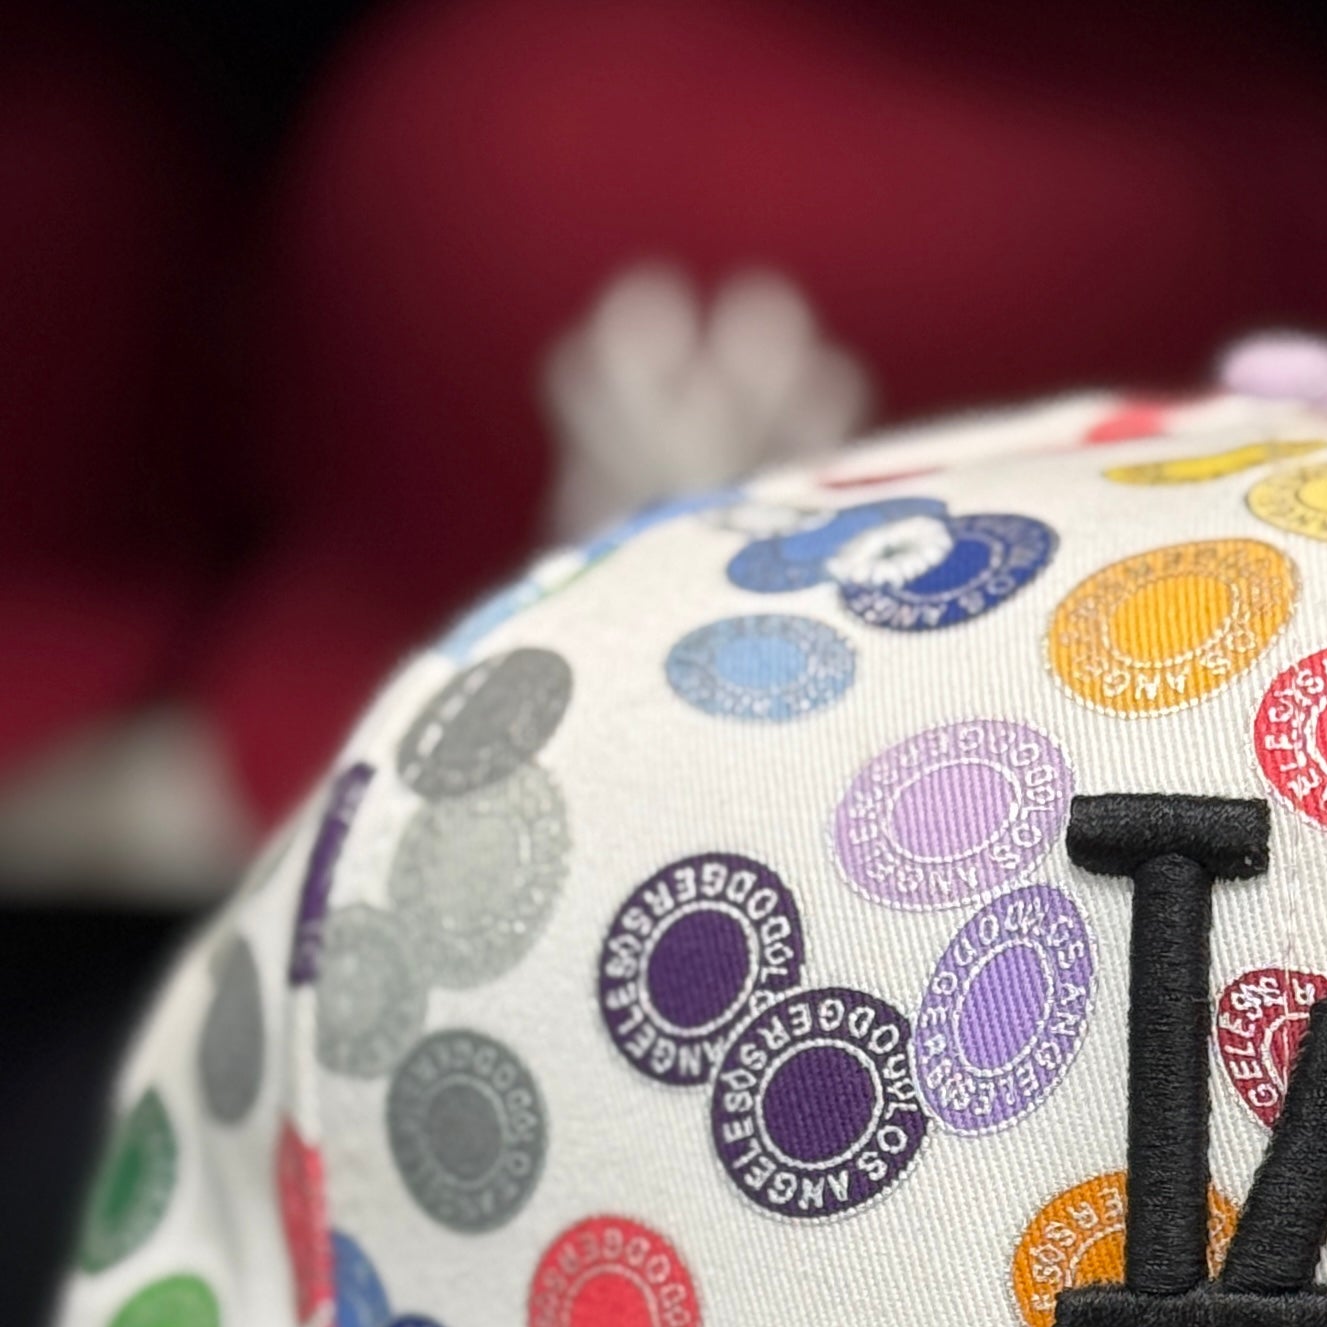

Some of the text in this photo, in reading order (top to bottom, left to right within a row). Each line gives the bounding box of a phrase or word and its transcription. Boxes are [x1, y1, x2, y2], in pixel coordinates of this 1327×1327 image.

[621, 862, 792, 944] DODGERS
[740, 999, 906, 1081] DODGERS
[1219, 990, 1279, 1108] GELES
[722, 1094, 919, 1210] LOS ANGELES
